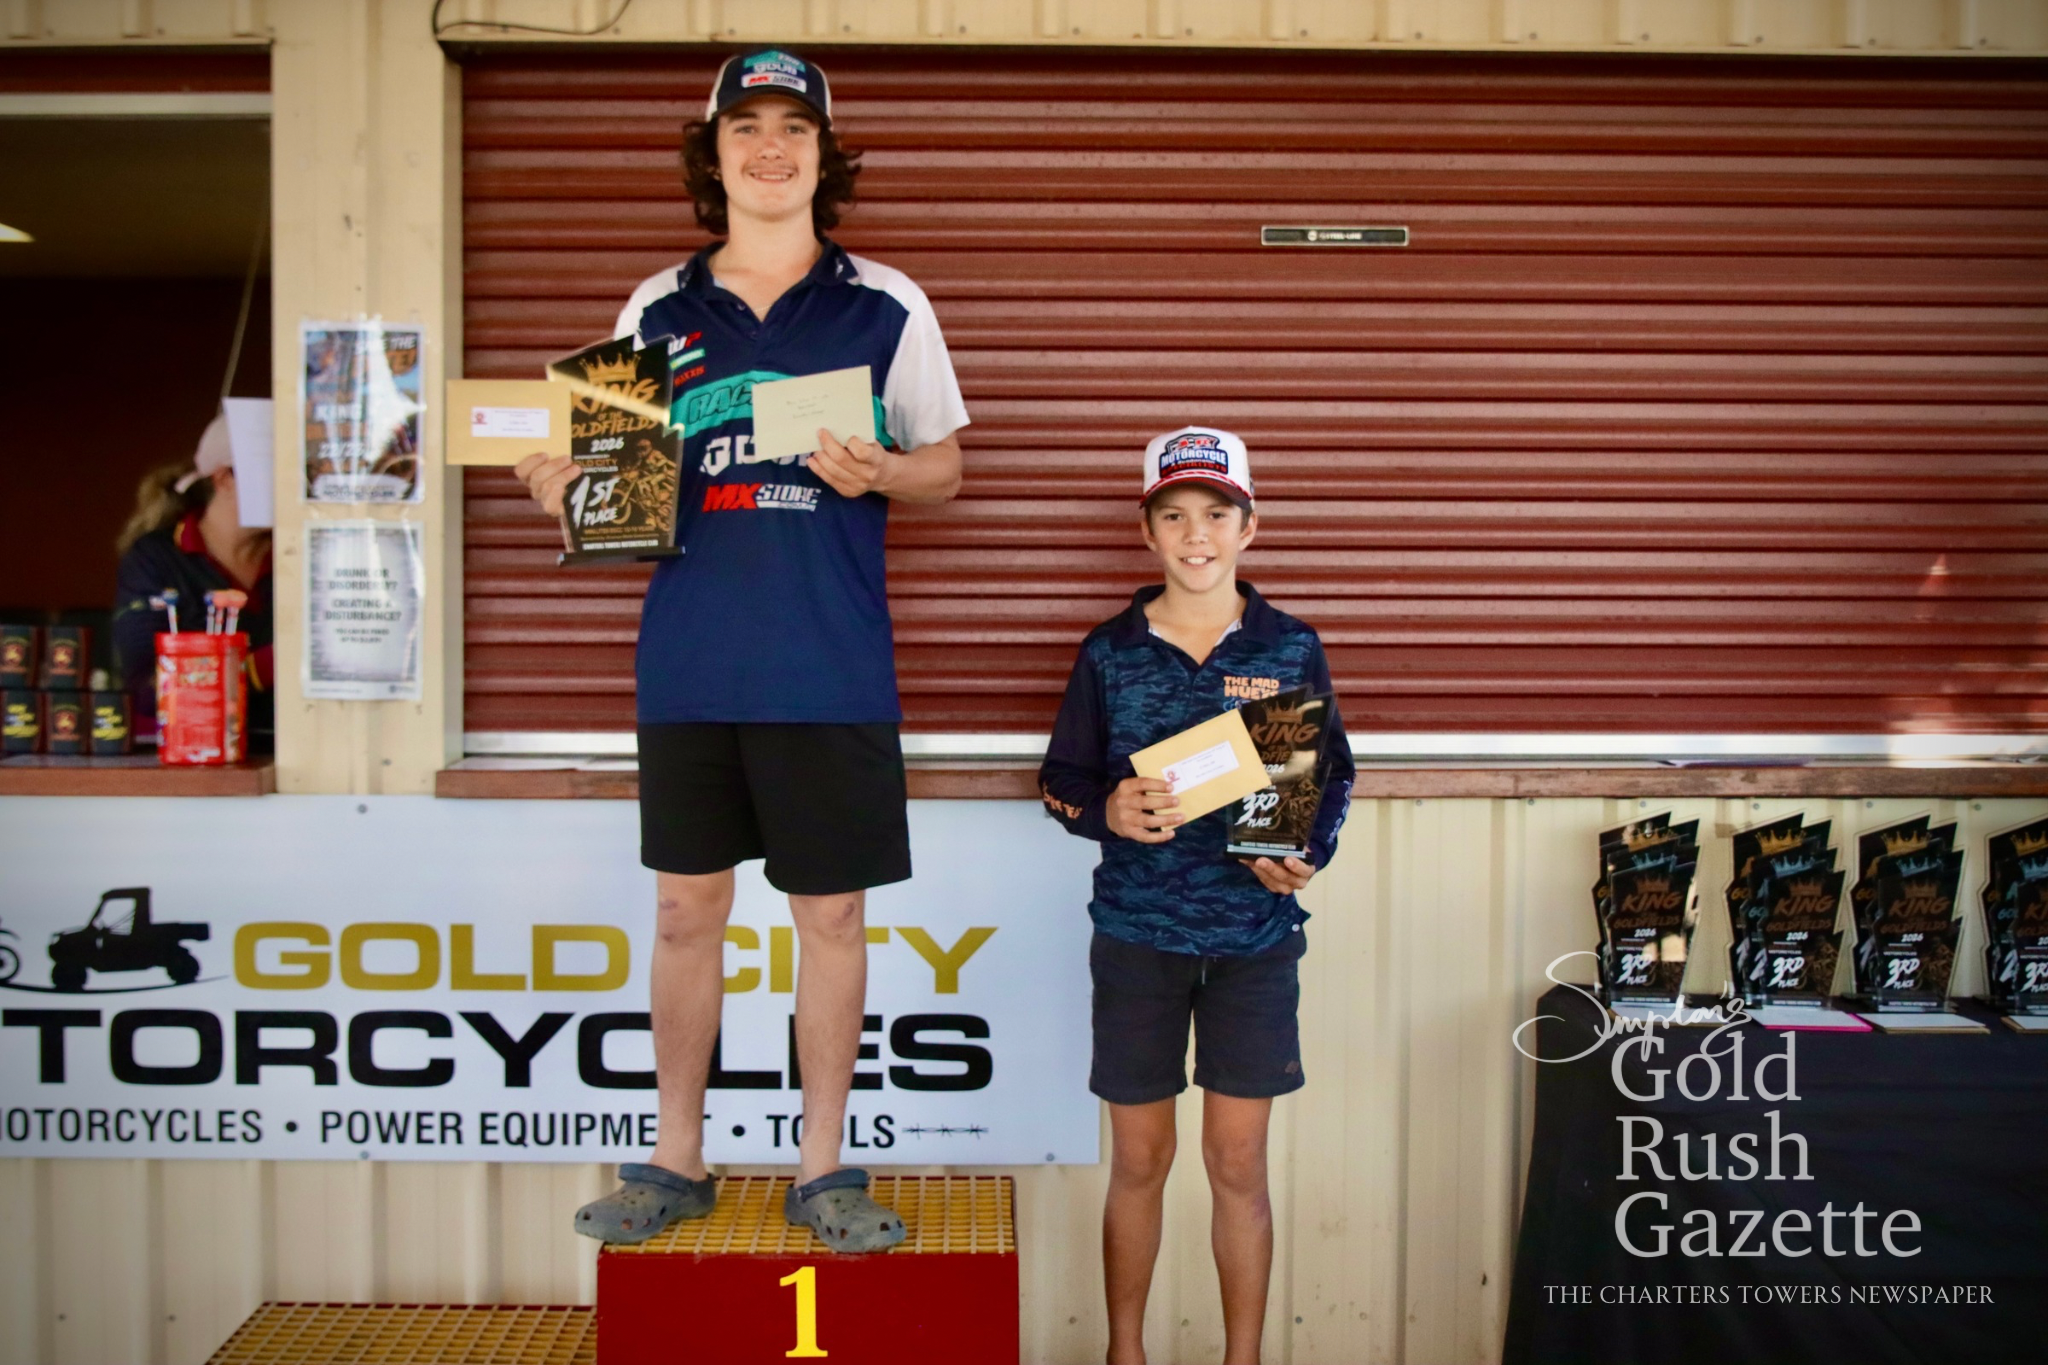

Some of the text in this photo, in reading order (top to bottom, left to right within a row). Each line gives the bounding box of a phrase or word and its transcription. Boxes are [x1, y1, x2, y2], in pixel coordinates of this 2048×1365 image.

[571, 416, 659, 438] OLDFIELDS
[590, 436, 625, 453] 2026
[1160, 449, 1228, 468] MOTORCYCLE
[570, 475, 621, 530] 1ST
[583, 507, 618, 527] PLACE
[328, 581, 398, 590] DISORDERY?
[1223, 676, 1280, 689] THE MAD
[1250, 723, 1320, 745] KING
[1234, 792, 1280, 826] 3RD
[1247, 817, 1273, 828] PLACE
[233, 921, 631, 992] GOLD
[1616, 953, 1652, 984] 3RD
[1767, 956, 1805, 987] 3RD
[1883, 958, 1920, 988] 3RD
[2020, 961, 2048, 992] 3R
[2, 1009, 993, 1092] TORCYCLS
[0, 1108, 896, 1149] OTORCYCLES POWER EQUIPME TOLS
[779, 1266, 829, 1358] 1
